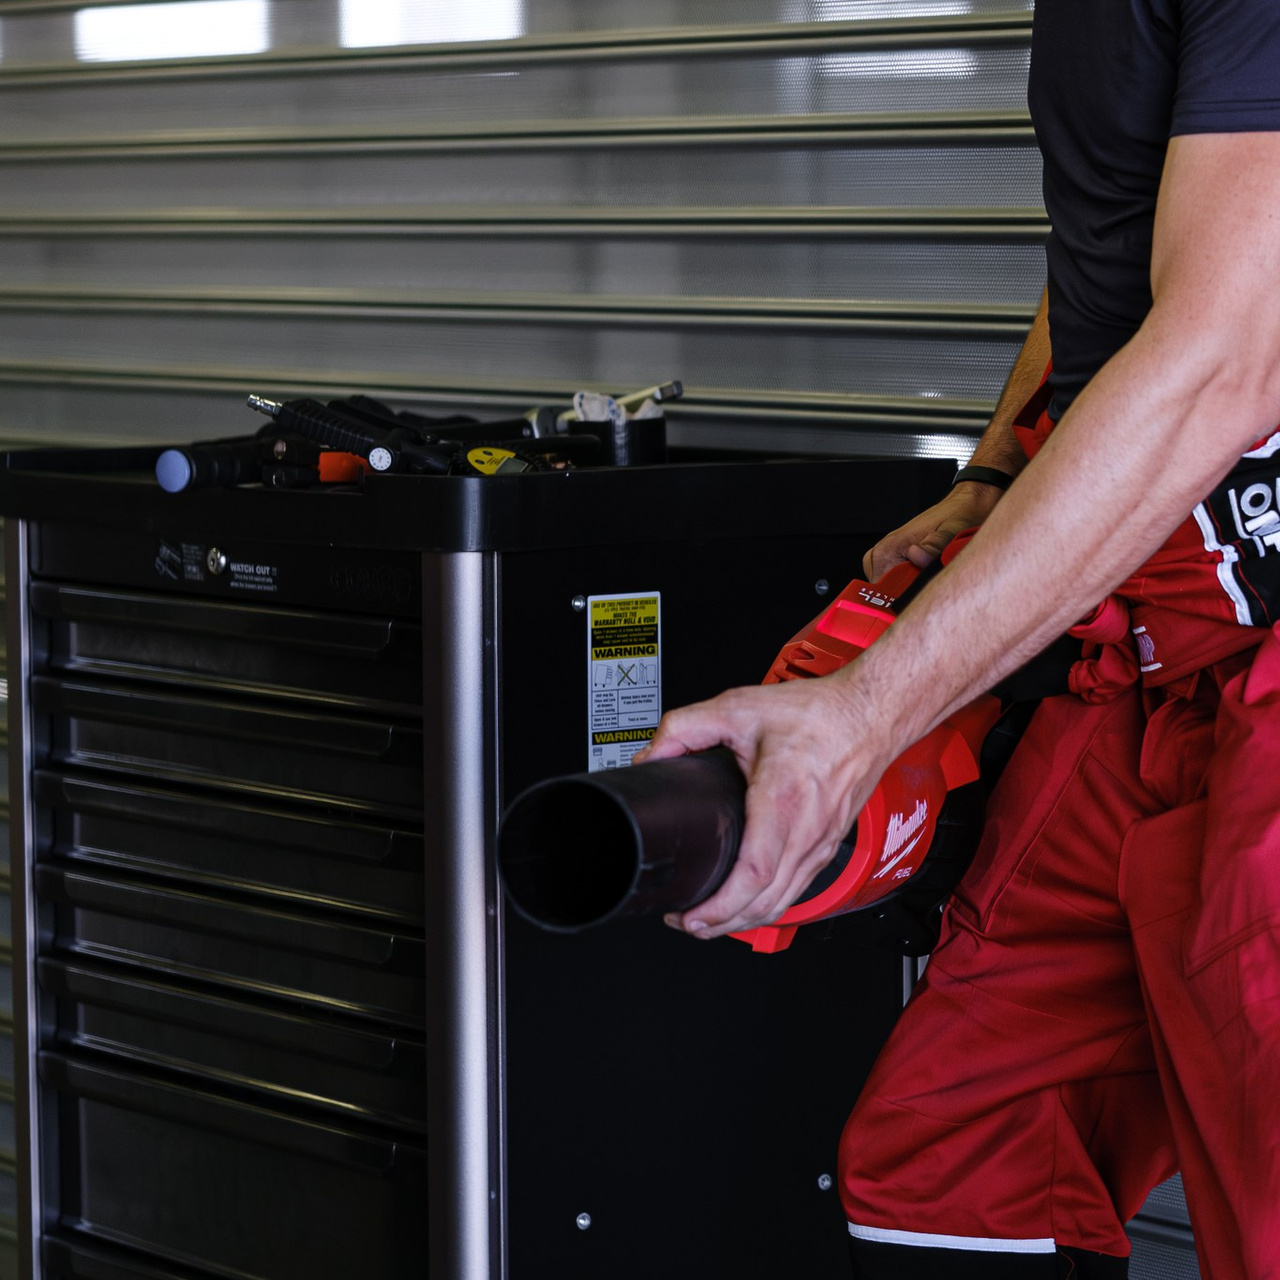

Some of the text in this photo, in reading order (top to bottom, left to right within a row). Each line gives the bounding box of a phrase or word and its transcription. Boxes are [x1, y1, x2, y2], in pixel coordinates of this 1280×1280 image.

[229, 562, 254, 574] WATCH
[255, 564, 271, 576] OUT
[594, 645, 656, 658] WARNING
